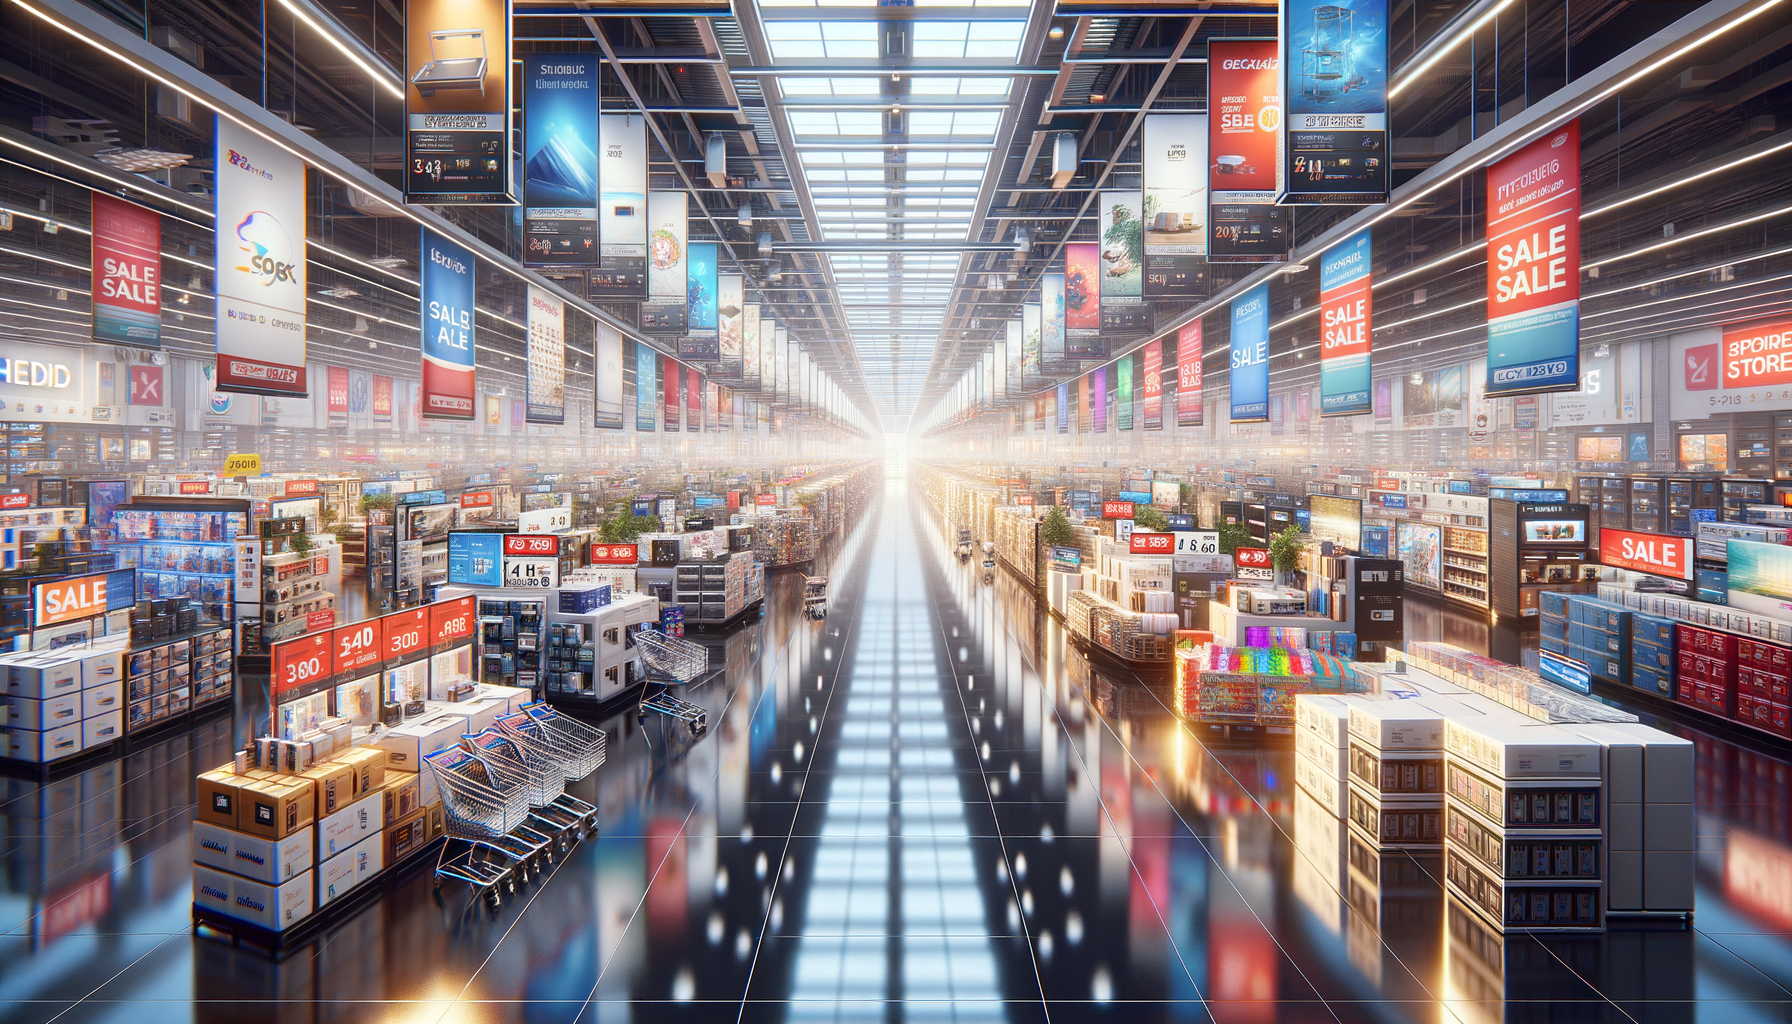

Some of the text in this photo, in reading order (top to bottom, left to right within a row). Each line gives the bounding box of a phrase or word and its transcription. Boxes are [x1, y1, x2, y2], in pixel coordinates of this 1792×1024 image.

[1497, 224, 1566, 271] SALE
[103, 257, 155, 284] SALE
[1496, 256, 1566, 303] SALE
[101, 278, 157, 305] SALE
[1325, 299, 1366, 327] SALE
[437, 327, 469, 350] ALE
[1325, 322, 1366, 349] SALE
[1232, 341, 1267, 369] SALE
[1621, 538, 1677, 567] SALE
[45, 580, 106, 614] SALE
